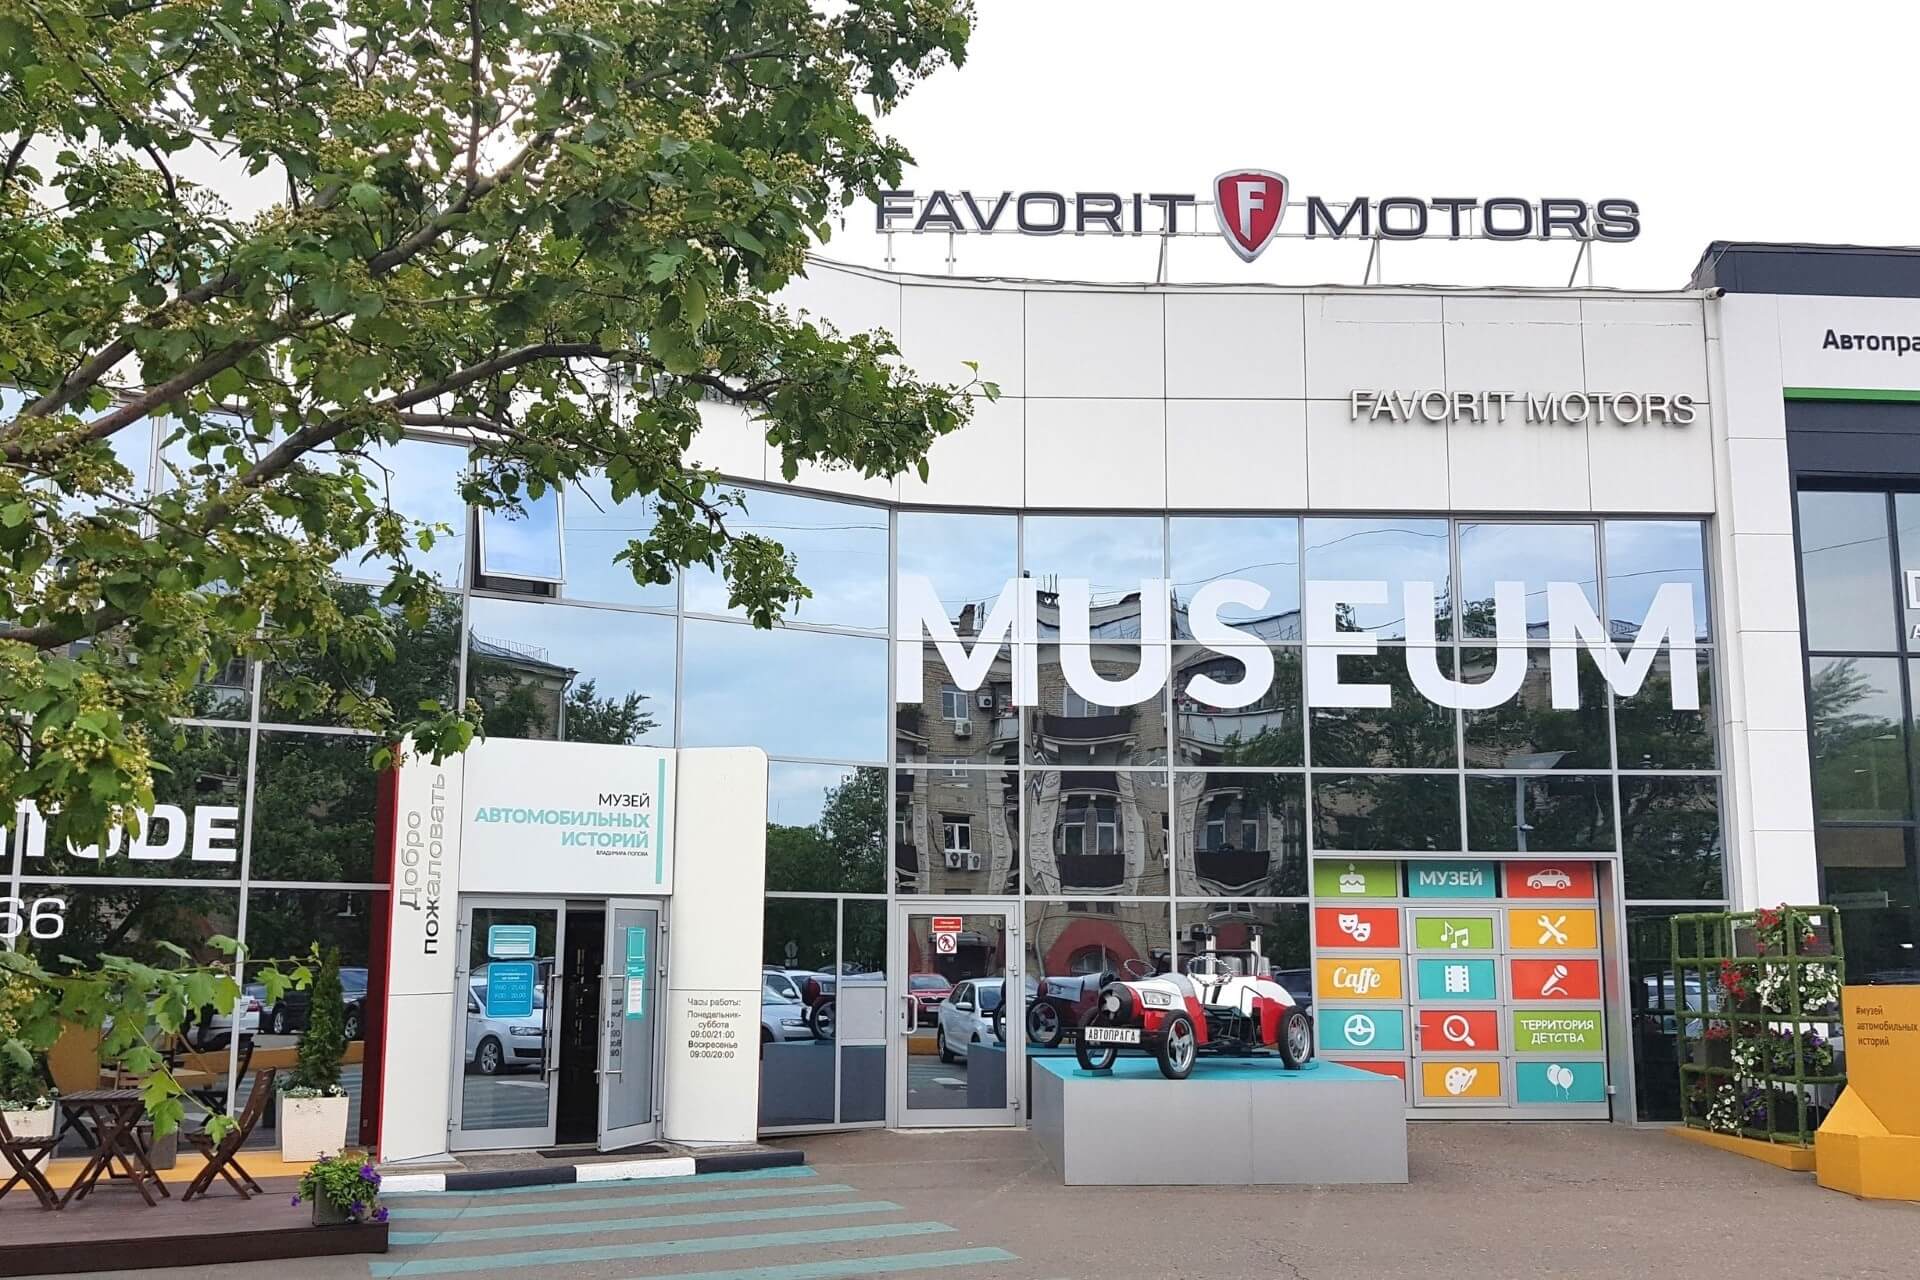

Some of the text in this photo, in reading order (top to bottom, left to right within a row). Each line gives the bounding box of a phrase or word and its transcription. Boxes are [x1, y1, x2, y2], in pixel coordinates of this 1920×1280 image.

[876, 190, 1196, 236] FAVORIT
[1305, 196, 1642, 243] MOTORS
[1350, 389, 1698, 426] FAVORIT MOTORS
[896, 577, 1701, 711] MUSEUM
[598, 793, 650, 808] МУЗЕЙ
[474, 807, 650, 828] АВТОМОБИЛЬНЫХ
[561, 830, 649, 849] ИСТОРИЙ
[400, 810, 425, 912] Добро
[424, 773, 446, 955] пожаловать
[1419, 868, 1483, 886] МУЗЕЙ
[1332, 966, 1382, 995] Caffe
[687, 998, 709, 1007] Часы
[698, 1020, 730, 1030] суббота
[1520, 1019, 1595, 1032] ТЕРРИТОРИЯ
[1857, 1021, 1919, 1032] автомобильных
[1088, 1028, 1137, 1041] АВТОПРАГА
[1531, 1032, 1586, 1045] ДЕТСТВА
[1858, 1036, 1890, 1048] историй
[688, 1040, 739, 1050] Воскресенье
